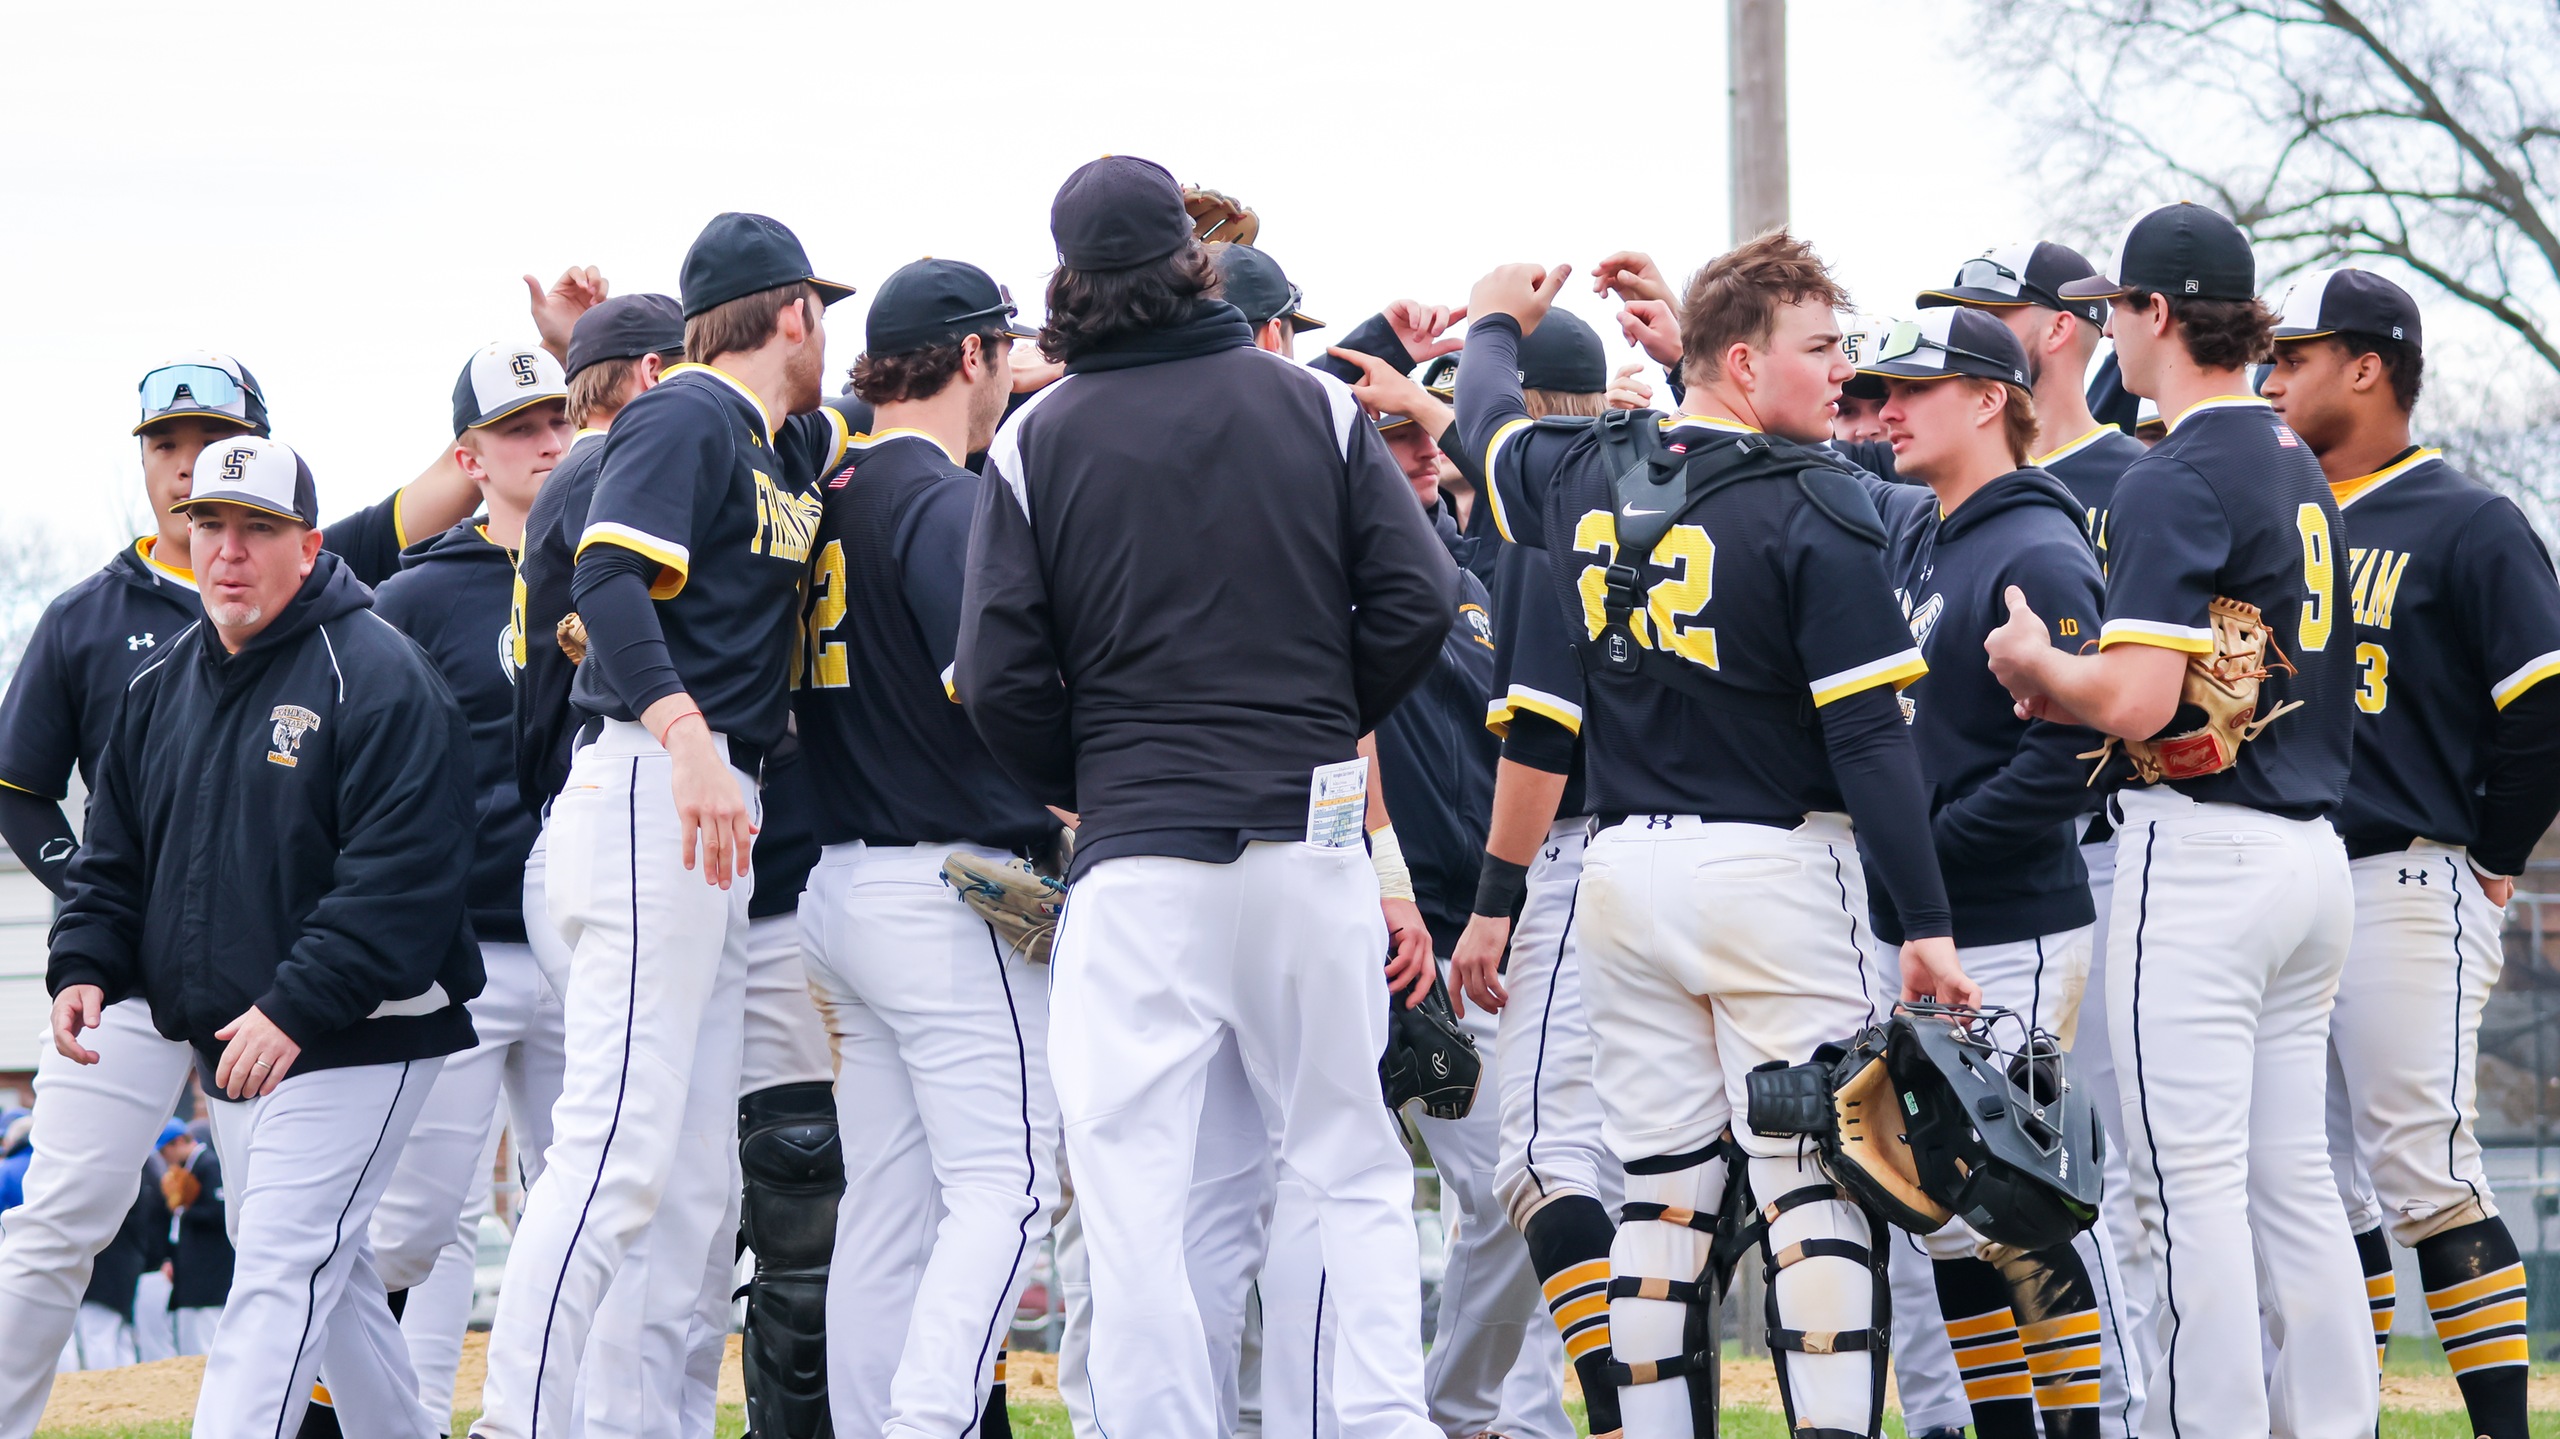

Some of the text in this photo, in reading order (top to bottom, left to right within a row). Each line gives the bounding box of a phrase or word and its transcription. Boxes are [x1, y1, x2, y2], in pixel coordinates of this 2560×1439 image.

[1573, 509, 1720, 671] 22
[2059, 618, 2079, 636] 10
[2296, 503, 2334, 652] 9
